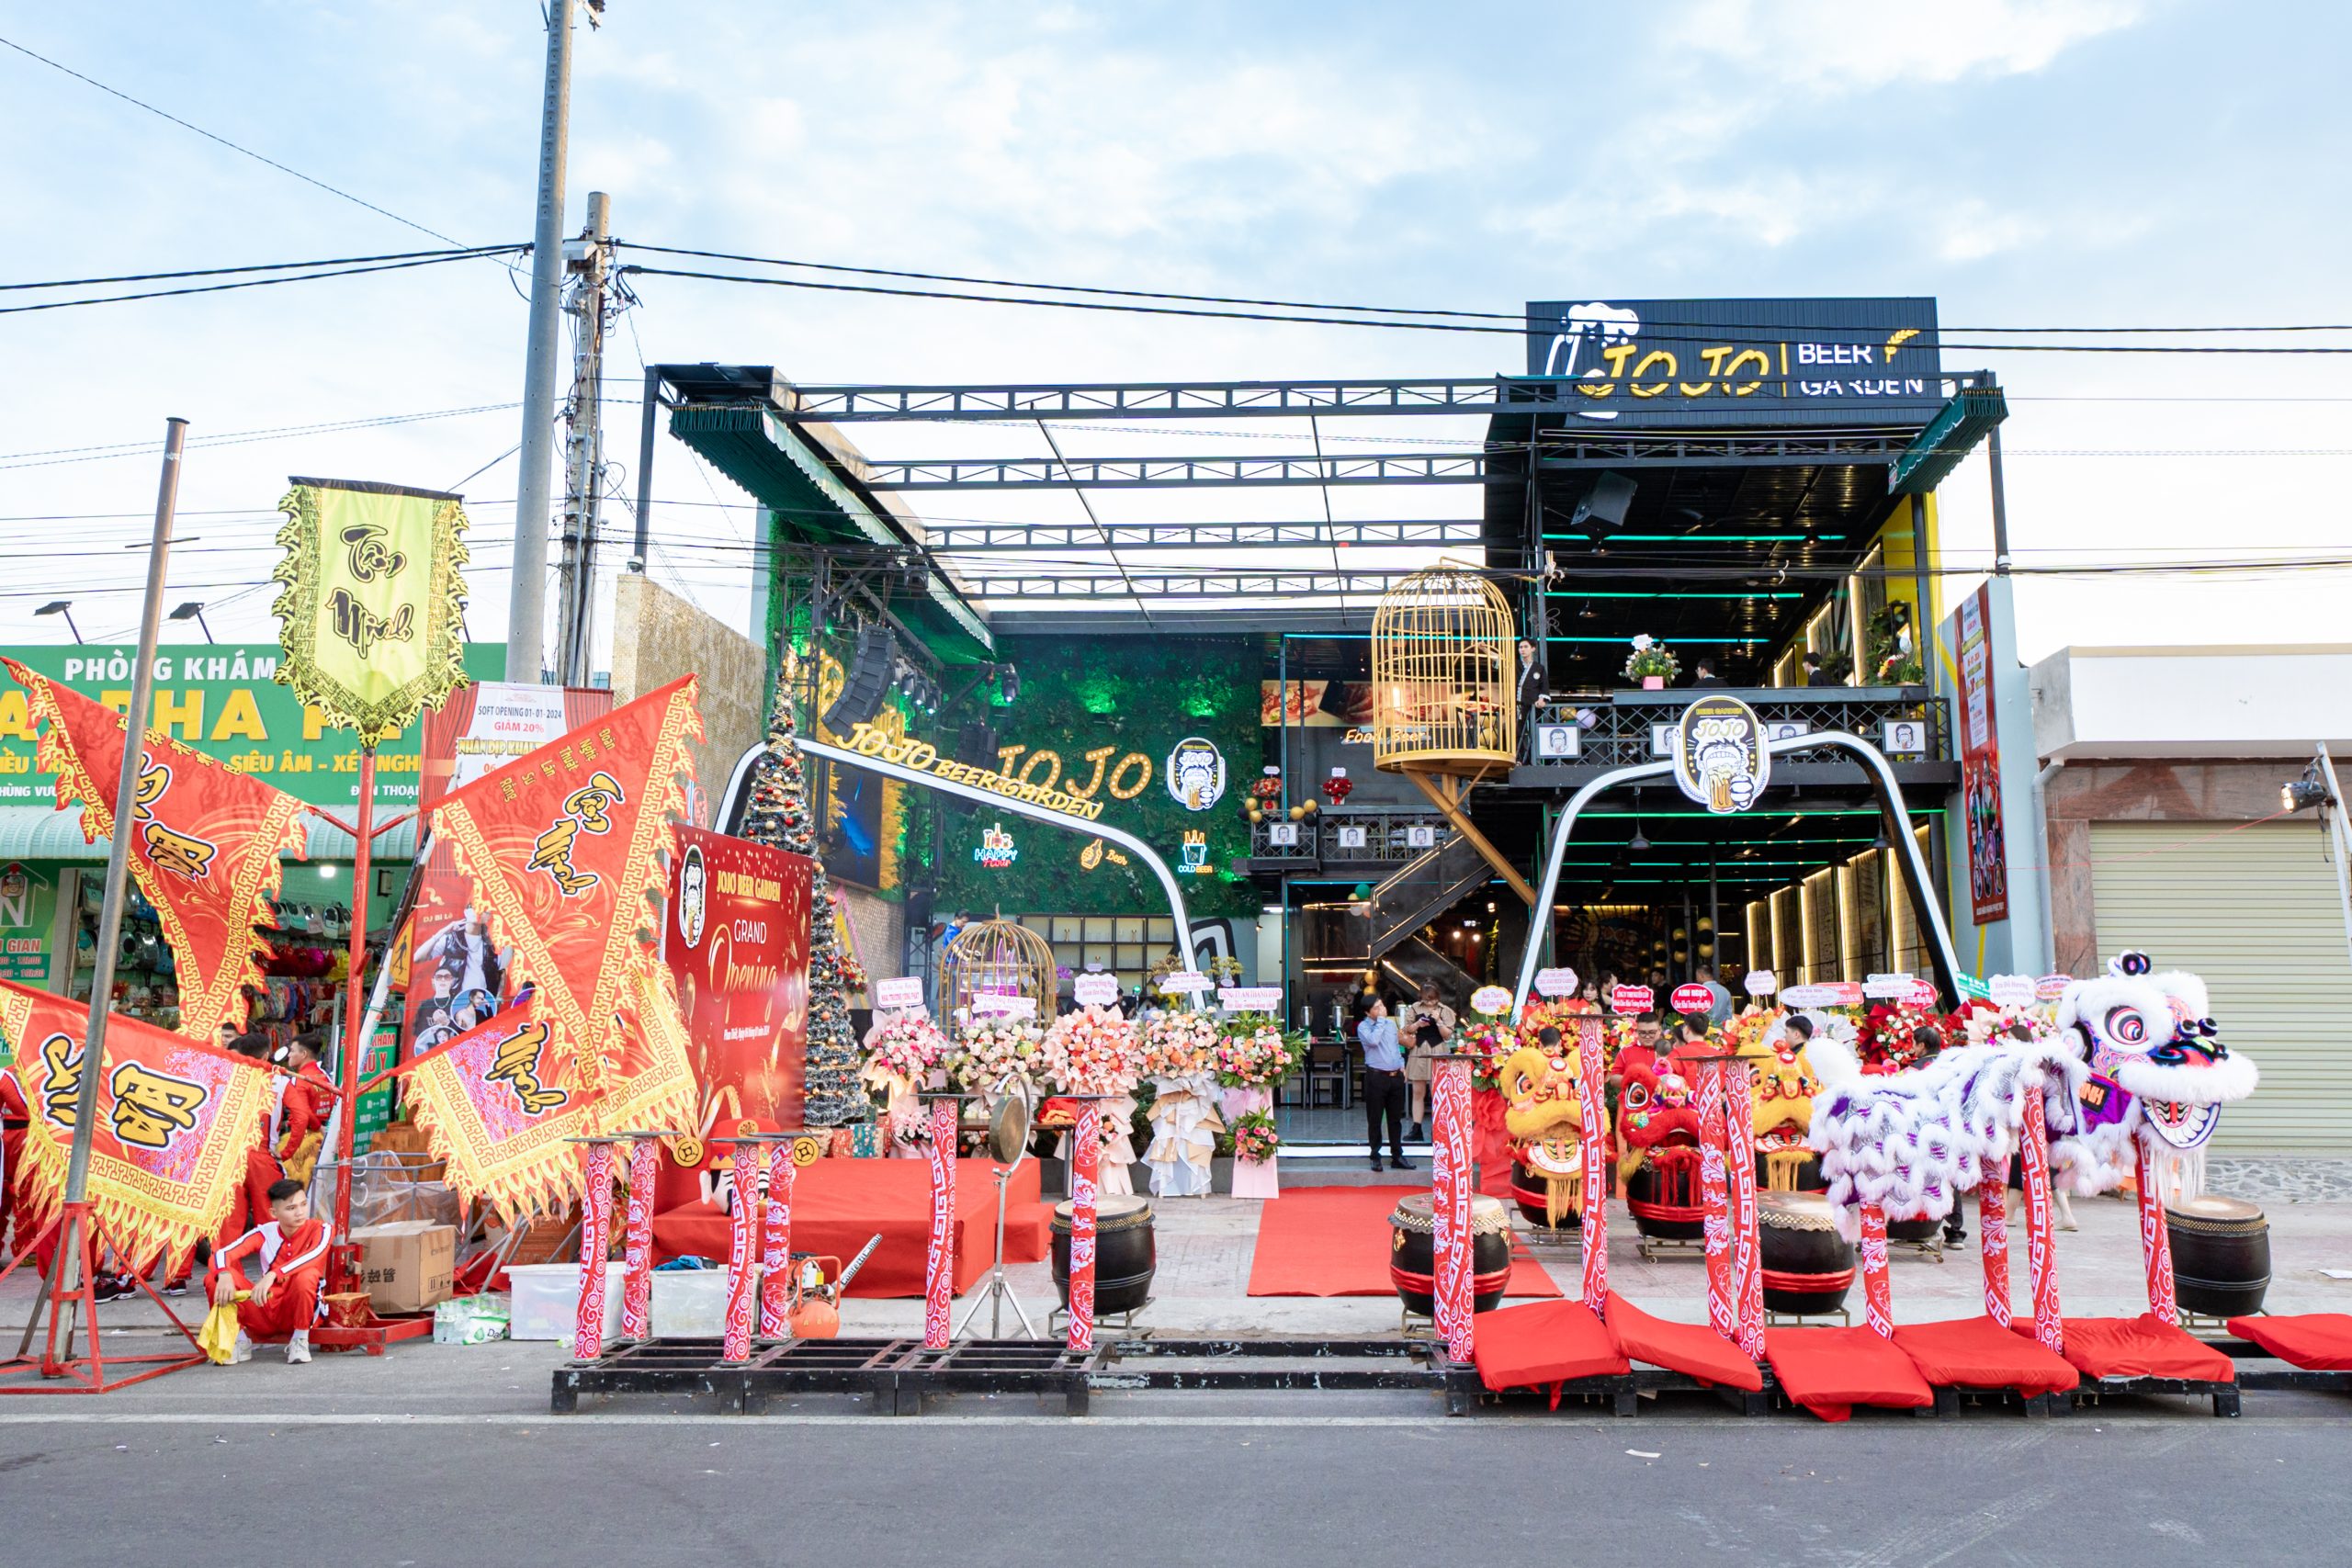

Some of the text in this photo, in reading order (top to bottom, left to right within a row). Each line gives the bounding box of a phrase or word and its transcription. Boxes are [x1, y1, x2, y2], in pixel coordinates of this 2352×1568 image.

[1798, 343, 1873, 365] BEER
[64, 649, 275, 682] PHÒG KHÁM
[478, 705, 494, 716] SOFT
[495, 706, 524, 717] OPENING
[546, 709, 562, 719] 2024
[523, 723, 545, 734] 20%
[1695, 721, 1745, 738] JOJO
[230, 750, 274, 773] SIÊU
[279, 750, 312, 773] ÂM
[333, 749, 363, 773] XÉ
[835, 722, 1103, 820] JOJO BEER GARDEN
[998, 744, 1152, 800] JOJO
[974, 847, 1018, 862] HAPPY
[1105, 849, 1128, 866] Beer
[1178, 864, 1213, 874] COLD BEER
[715, 870, 736, 896] JOJO
[738, 874, 754, 898] BEER
[755, 878, 781, 903] GARDEN
[734, 919, 767, 944] GRAND
[7, 939, 41, 953] GIAN
[708, 923, 778, 1024] Opening
